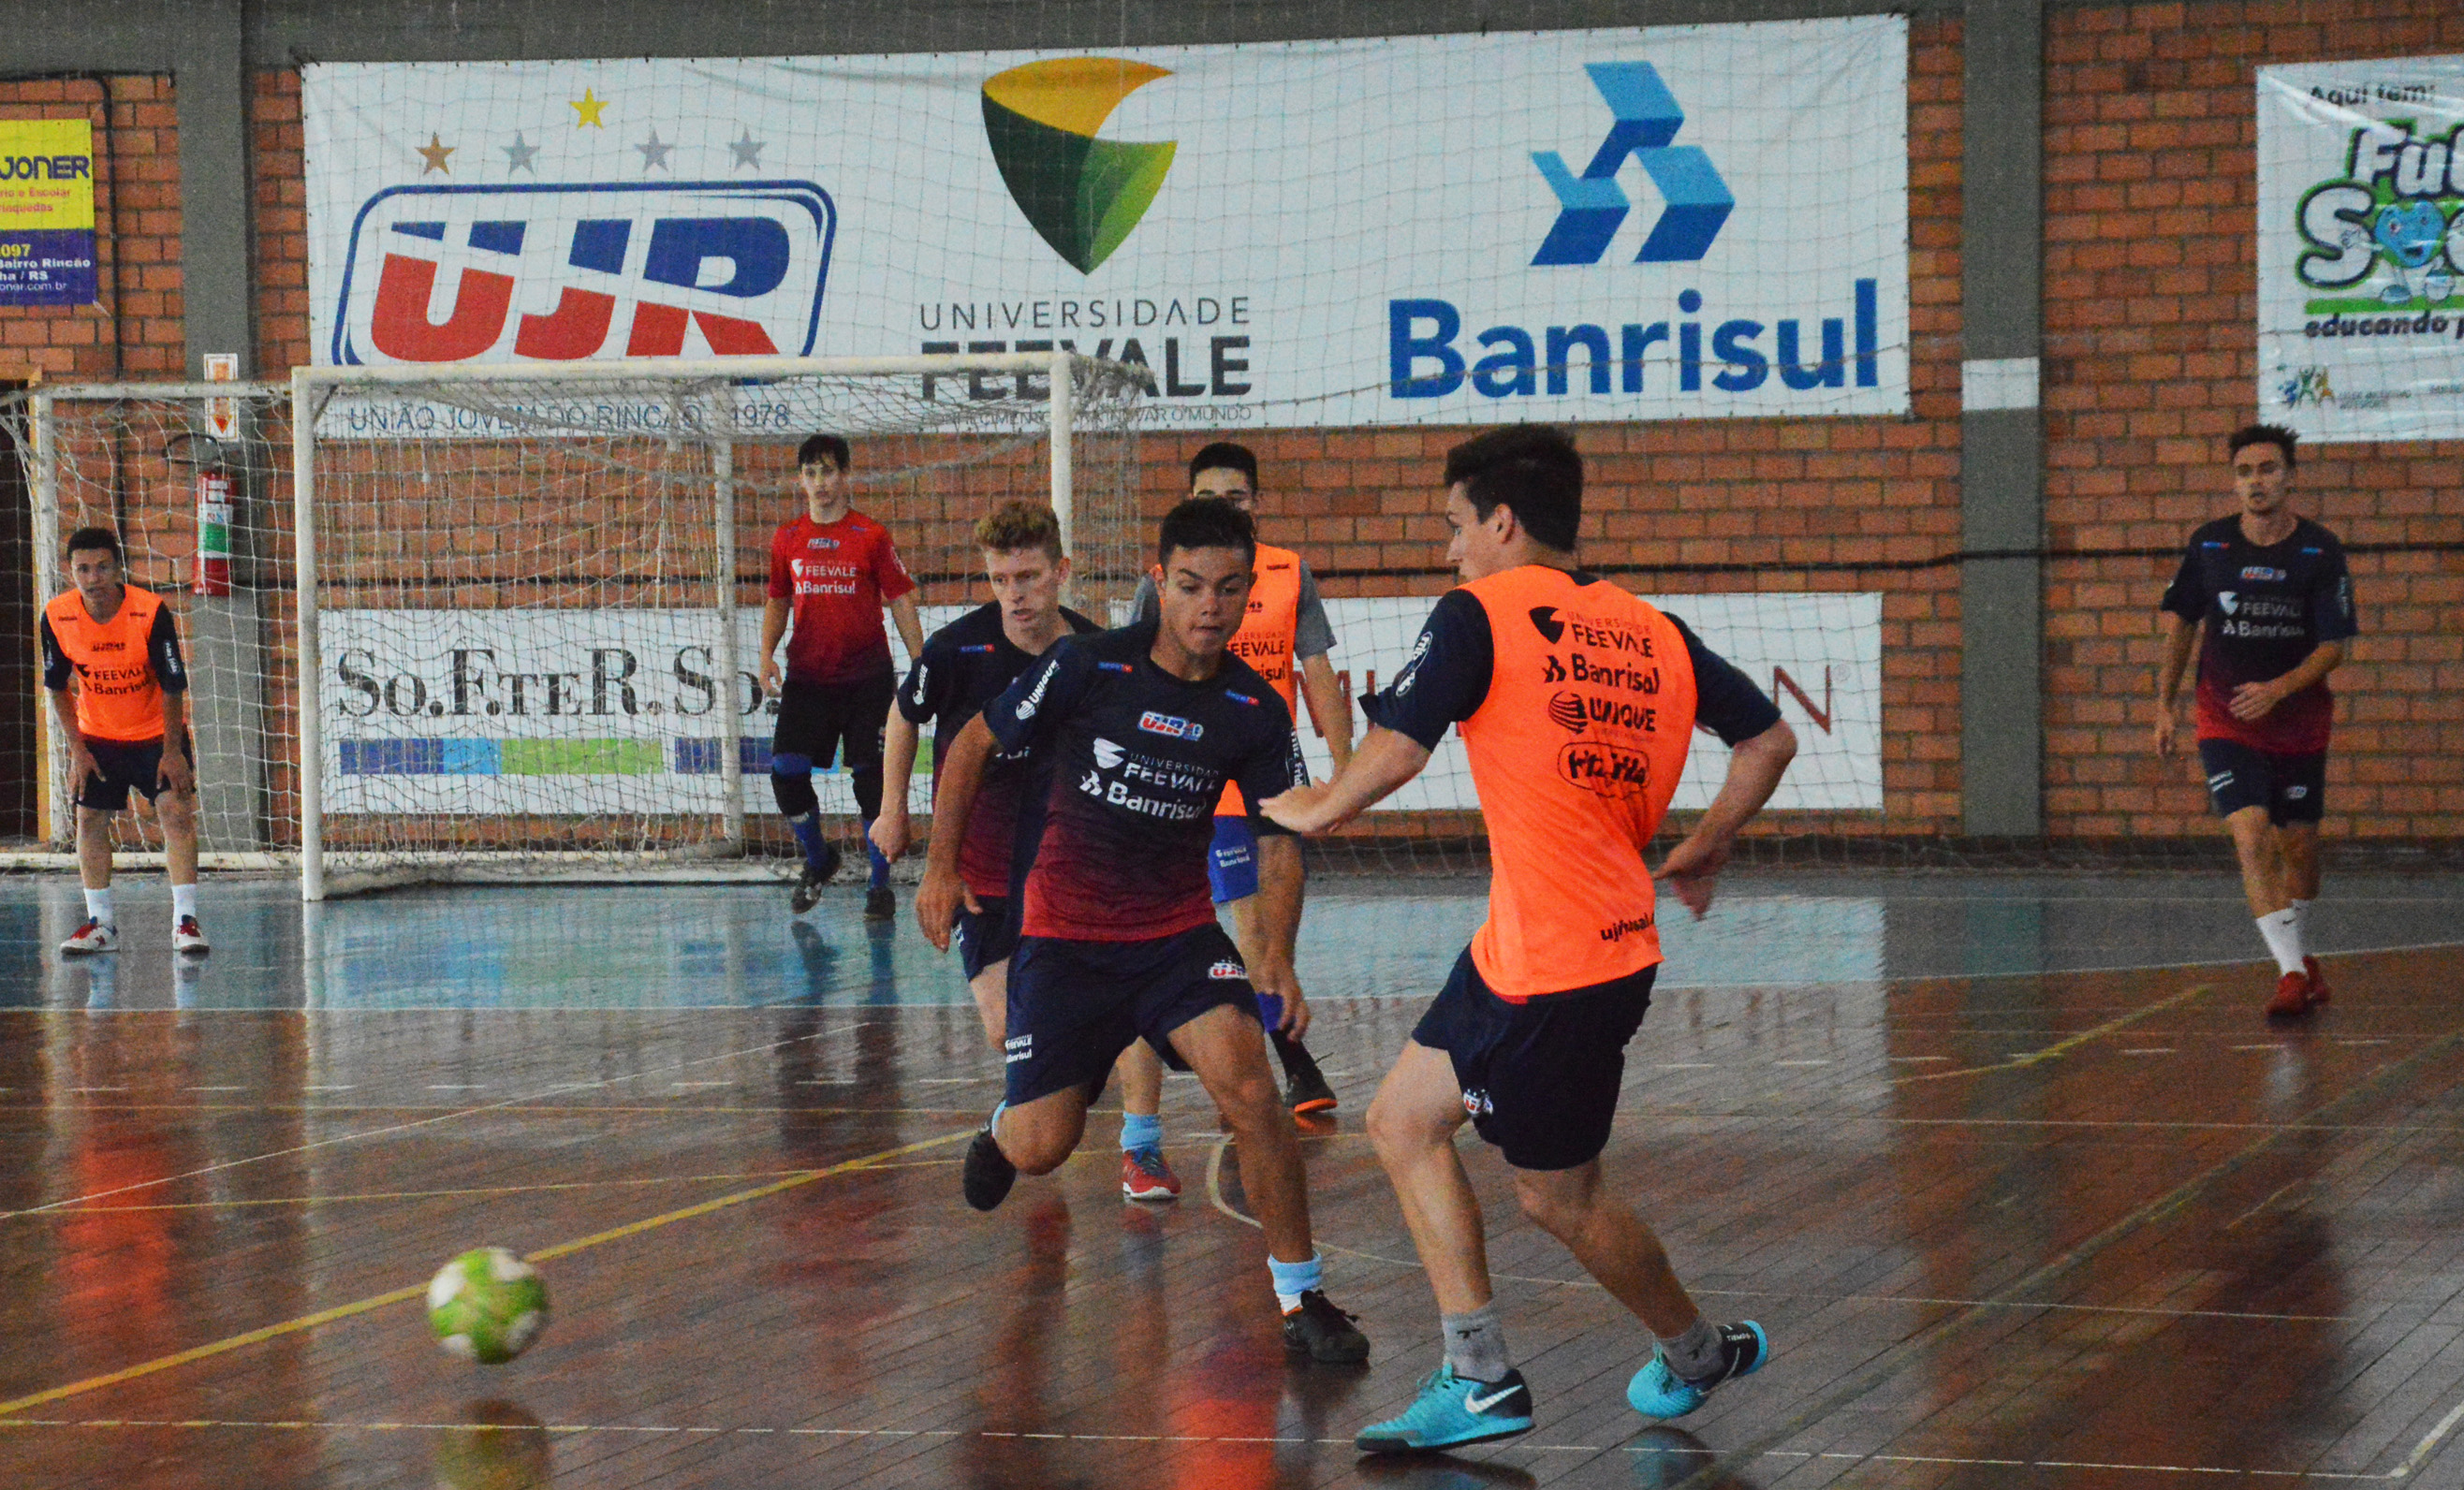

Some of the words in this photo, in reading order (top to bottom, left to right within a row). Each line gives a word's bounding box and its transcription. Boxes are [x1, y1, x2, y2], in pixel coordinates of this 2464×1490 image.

[42, 257, 91, 268] Rincão
[28, 270, 49, 280] RS
[372, 216, 790, 362] UJR
[920, 297, 1250, 330] UNIVERSIDADE
[2305, 310, 2449, 338] educando
[1389, 278, 1878, 398] Banrisul
[1188, 406, 1252, 421] MUNDO
[805, 565, 858, 577] FEEVALE
[803, 580, 857, 594] Banrisul
[2242, 602, 2302, 618] FEEVAL
[1226, 640, 1285, 658] EEVALE
[1028, 659, 1060, 705] UNIQUE
[1130, 752, 1220, 778] UNIVERSIDAD
[1107, 781, 1208, 820] Banrisul
